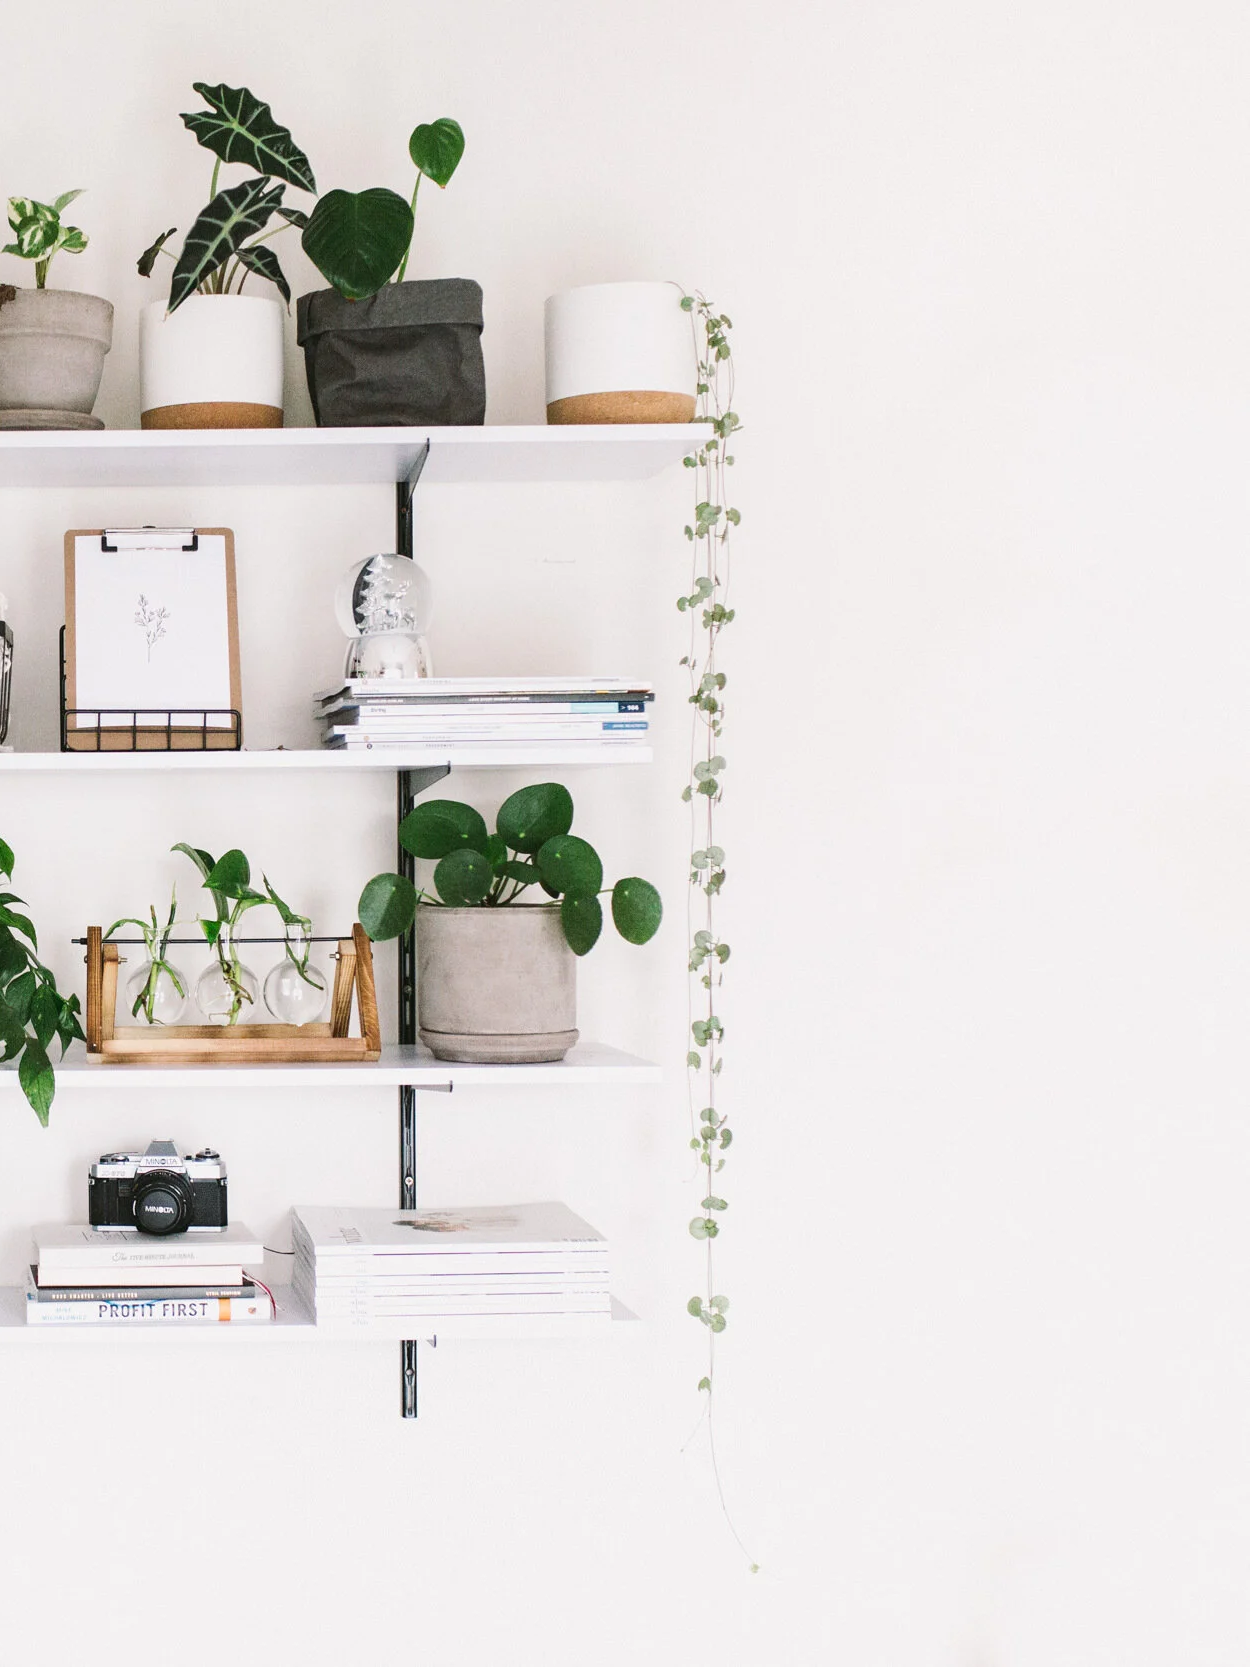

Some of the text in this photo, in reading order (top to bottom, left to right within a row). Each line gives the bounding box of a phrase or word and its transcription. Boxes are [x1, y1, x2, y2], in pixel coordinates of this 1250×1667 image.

[144, 1205, 175, 1214] MINOLTA
[98, 1303, 209, 1318] PROFIT FIRST
